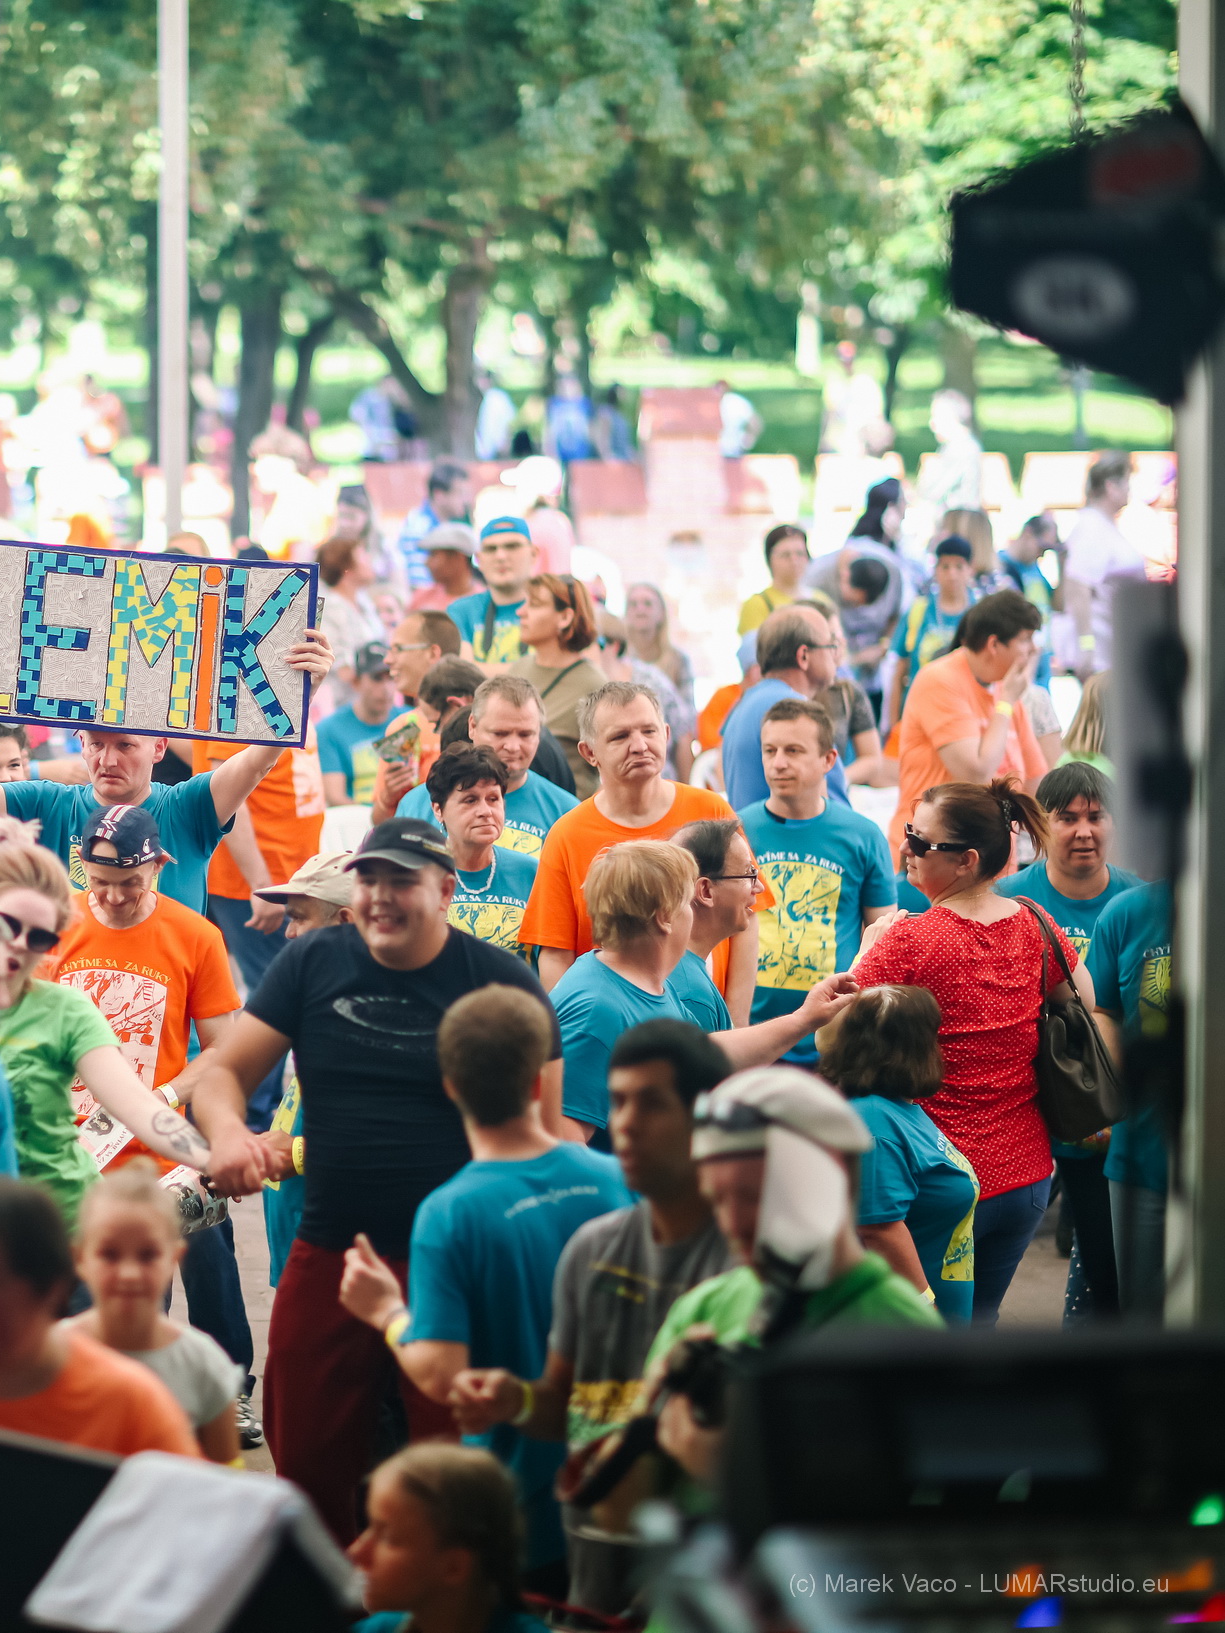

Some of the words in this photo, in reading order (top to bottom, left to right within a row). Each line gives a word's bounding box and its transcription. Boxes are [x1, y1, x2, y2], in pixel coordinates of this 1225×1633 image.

[505, 819, 518, 829] ZA
[519, 822, 546, 838] RUKY
[788, 852, 799, 861] SA
[804, 854, 818, 864] ZA
[819, 857, 845, 875] RUKY
[469, 894, 482, 903] SA
[486, 894, 500, 903] ZA
[502, 896, 527, 909] RUKY
[1074, 927, 1086, 937] SA
[105, 959, 118, 968] SA
[123, 961, 139, 972] ZA
[141, 966, 171, 985] RUKY
